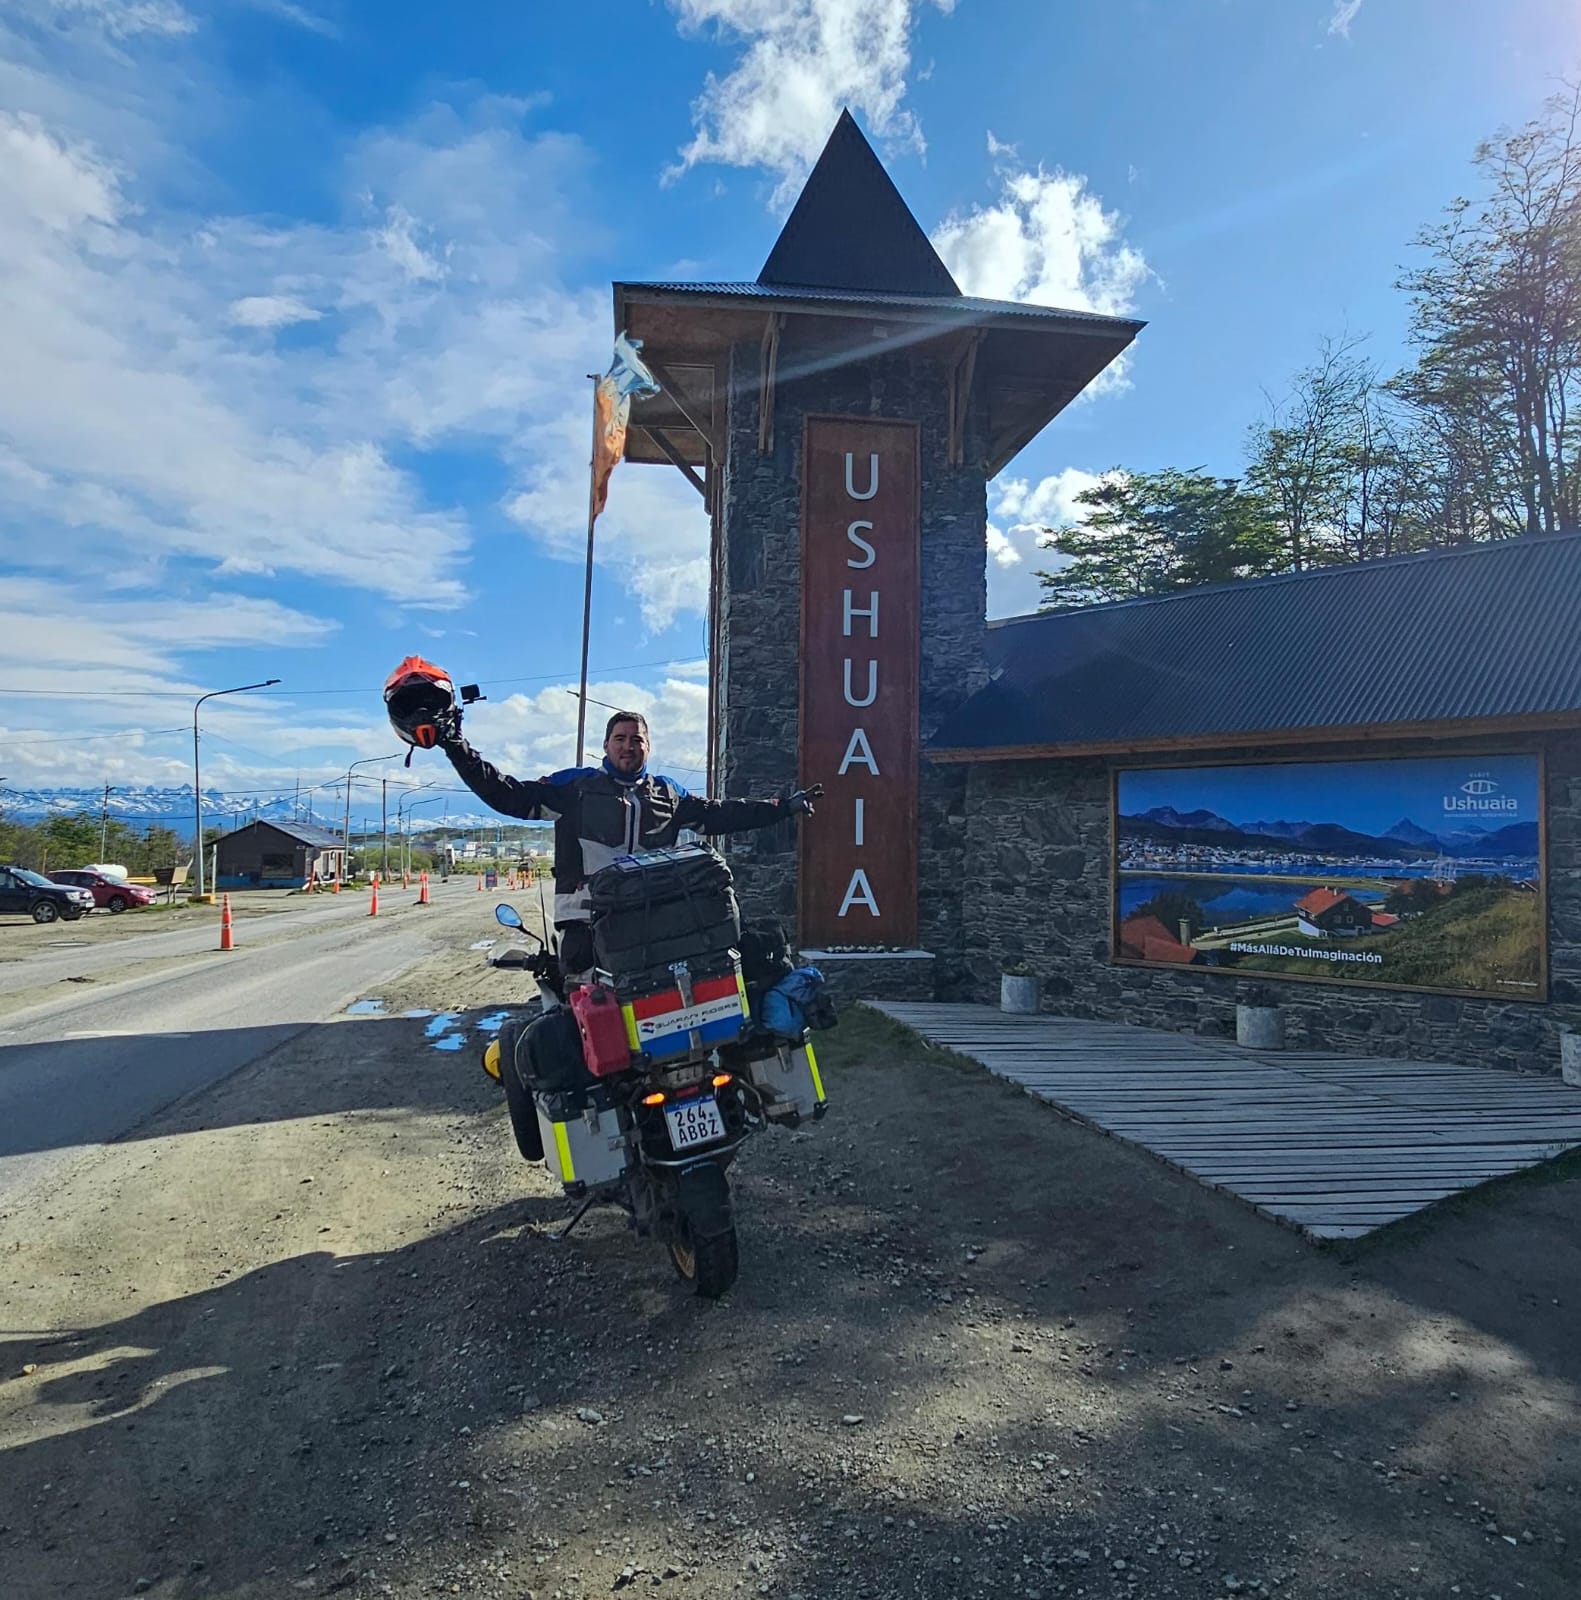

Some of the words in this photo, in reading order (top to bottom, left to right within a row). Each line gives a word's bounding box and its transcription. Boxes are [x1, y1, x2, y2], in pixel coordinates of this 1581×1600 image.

[838, 453, 880, 917] USHUAIA
[1443, 795, 1518, 811] Ushuaia
[1230, 942, 1382, 963] #MásAlláDeTuImaginación
[675, 1105, 707, 1127] 264
[679, 1119, 719, 1144] ABBZ
